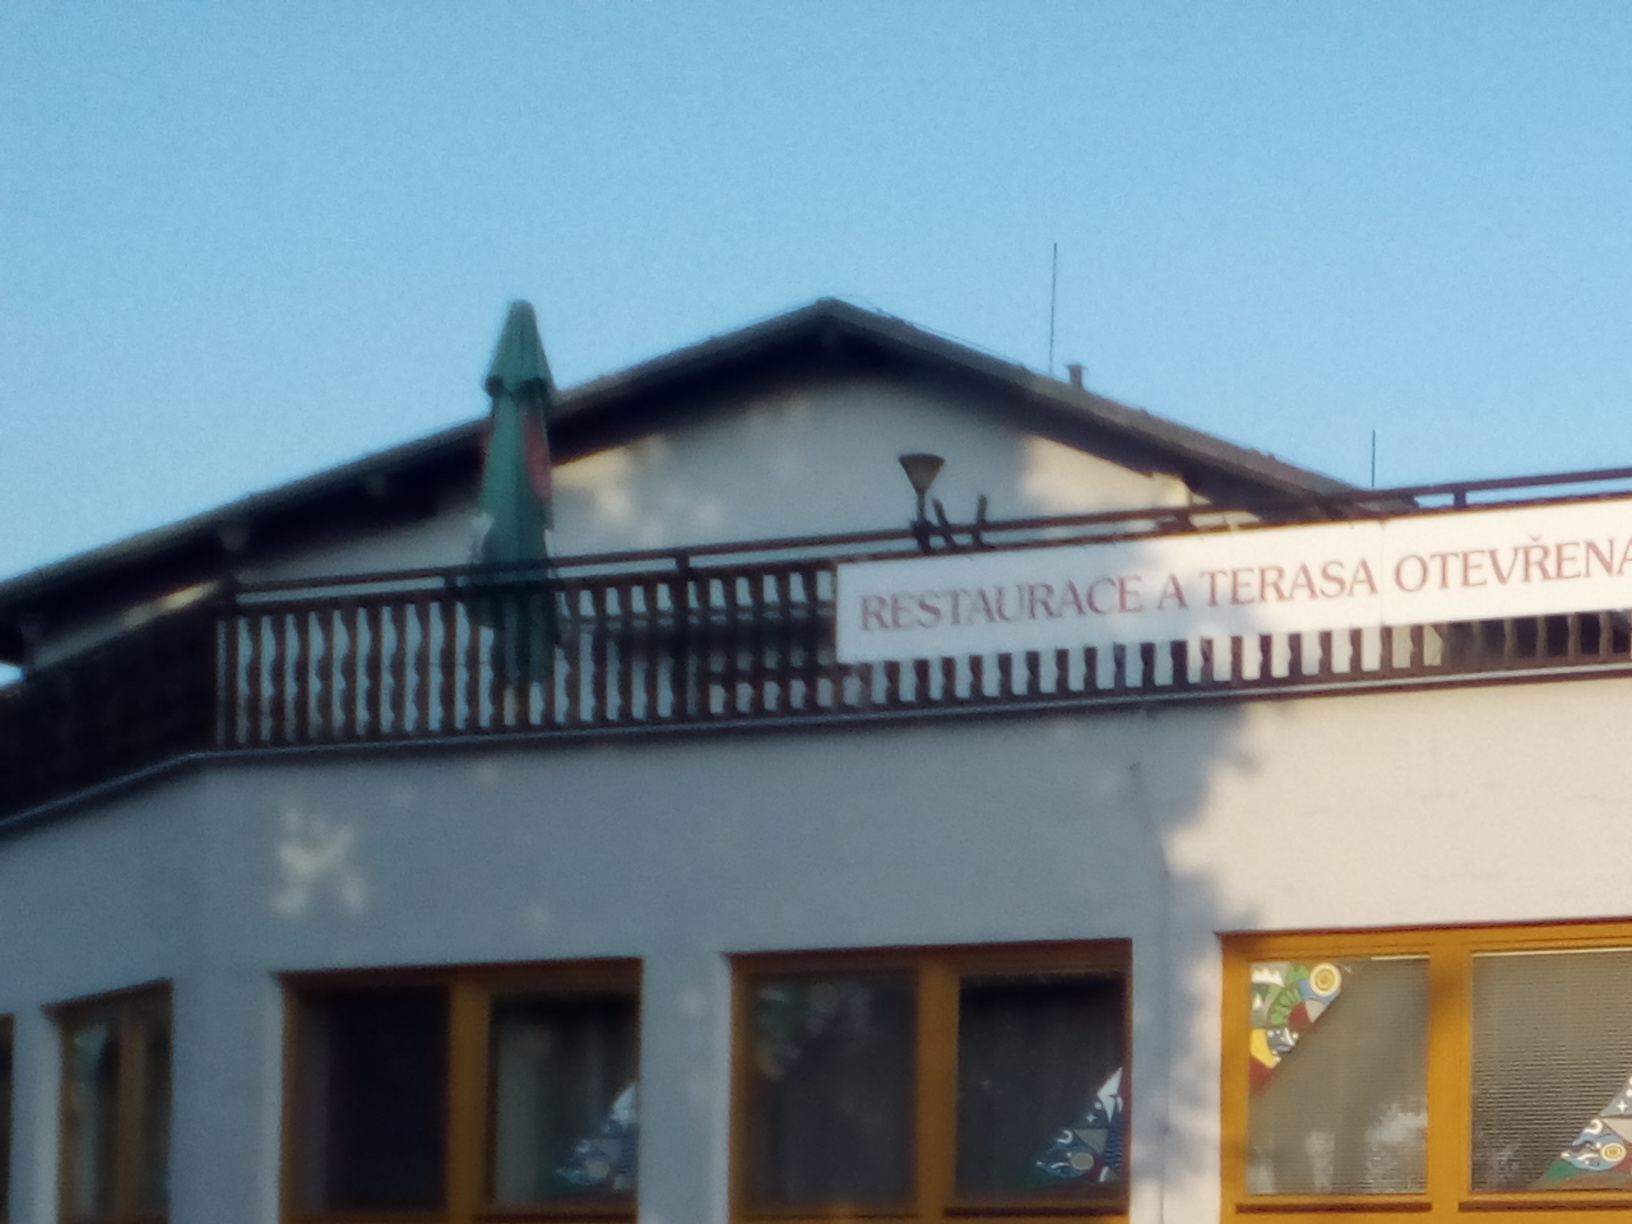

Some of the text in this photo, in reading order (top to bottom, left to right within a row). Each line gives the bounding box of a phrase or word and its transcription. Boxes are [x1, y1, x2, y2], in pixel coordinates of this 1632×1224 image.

[859, 576, 1144, 633] RESTAURACE
[1158, 575, 1191, 608] A
[1198, 561, 1380, 606] TERASA
